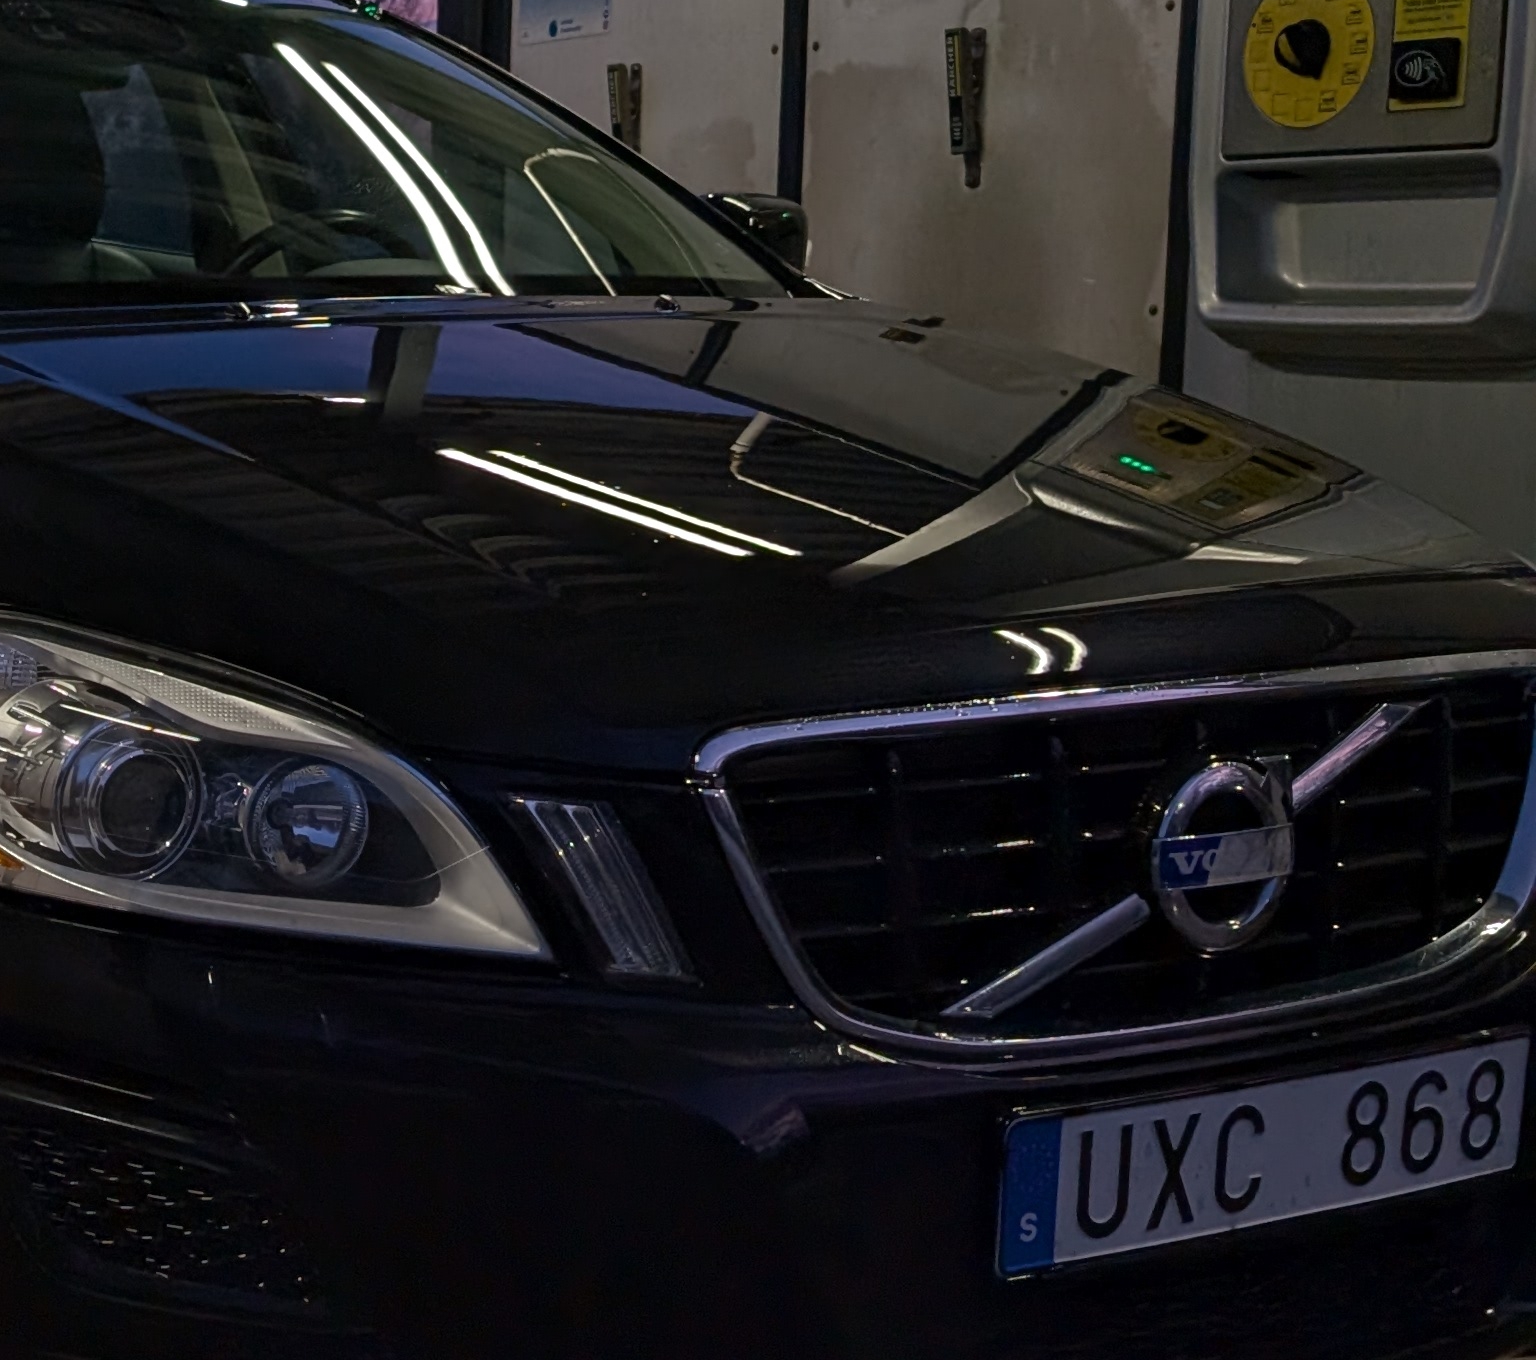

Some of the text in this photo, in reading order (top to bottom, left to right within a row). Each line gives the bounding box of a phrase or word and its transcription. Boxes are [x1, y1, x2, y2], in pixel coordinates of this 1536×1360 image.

[1075, 1058, 1505, 1239] UXC 868
[1019, 1212, 1038, 1243] S
